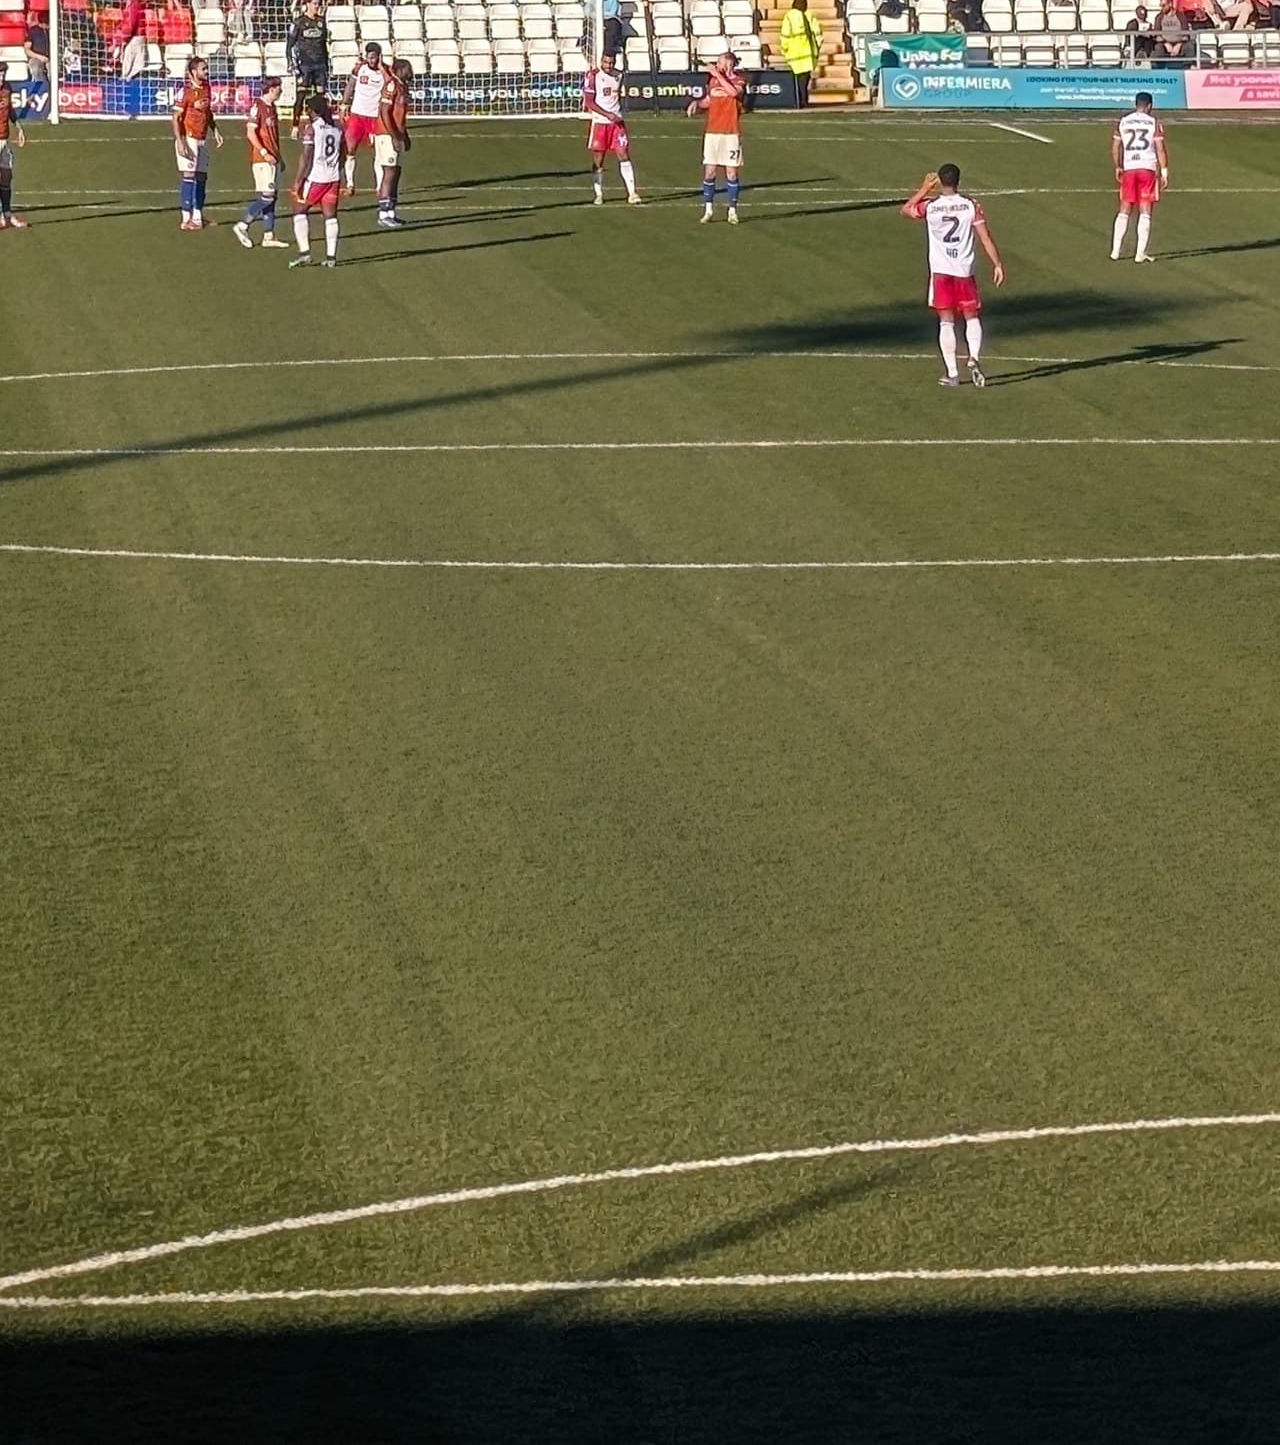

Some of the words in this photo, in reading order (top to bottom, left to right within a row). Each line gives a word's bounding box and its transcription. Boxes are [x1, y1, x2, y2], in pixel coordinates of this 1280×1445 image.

[11, 87, 49, 114] sky
[58, 87, 98, 108] bet
[428, 86, 485, 101] Things
[487, 89, 518, 102] you
[520, 84, 563, 99] need
[565, 86, 584, 99] to
[629, 87, 639, 98] a
[640, 83, 703, 100] gaming
[324, 134, 336, 156] 8
[1124, 128, 1150, 151] 23
[941, 215, 961, 243] 2
